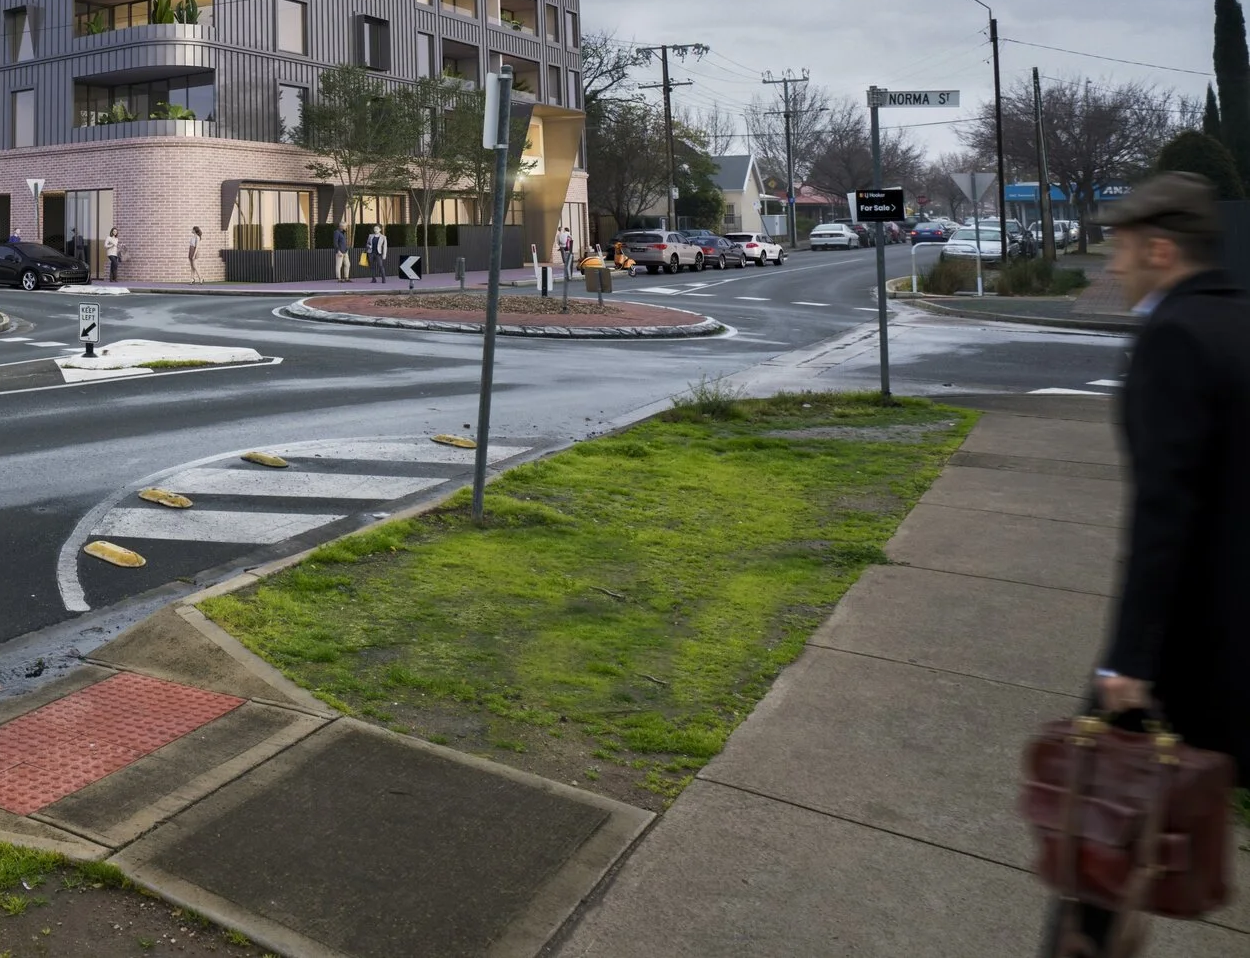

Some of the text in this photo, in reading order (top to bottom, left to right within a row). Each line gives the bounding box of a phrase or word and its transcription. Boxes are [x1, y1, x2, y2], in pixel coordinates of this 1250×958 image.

[888, 93, 930, 105] NORMA
[860, 204, 890, 212] For Sale
